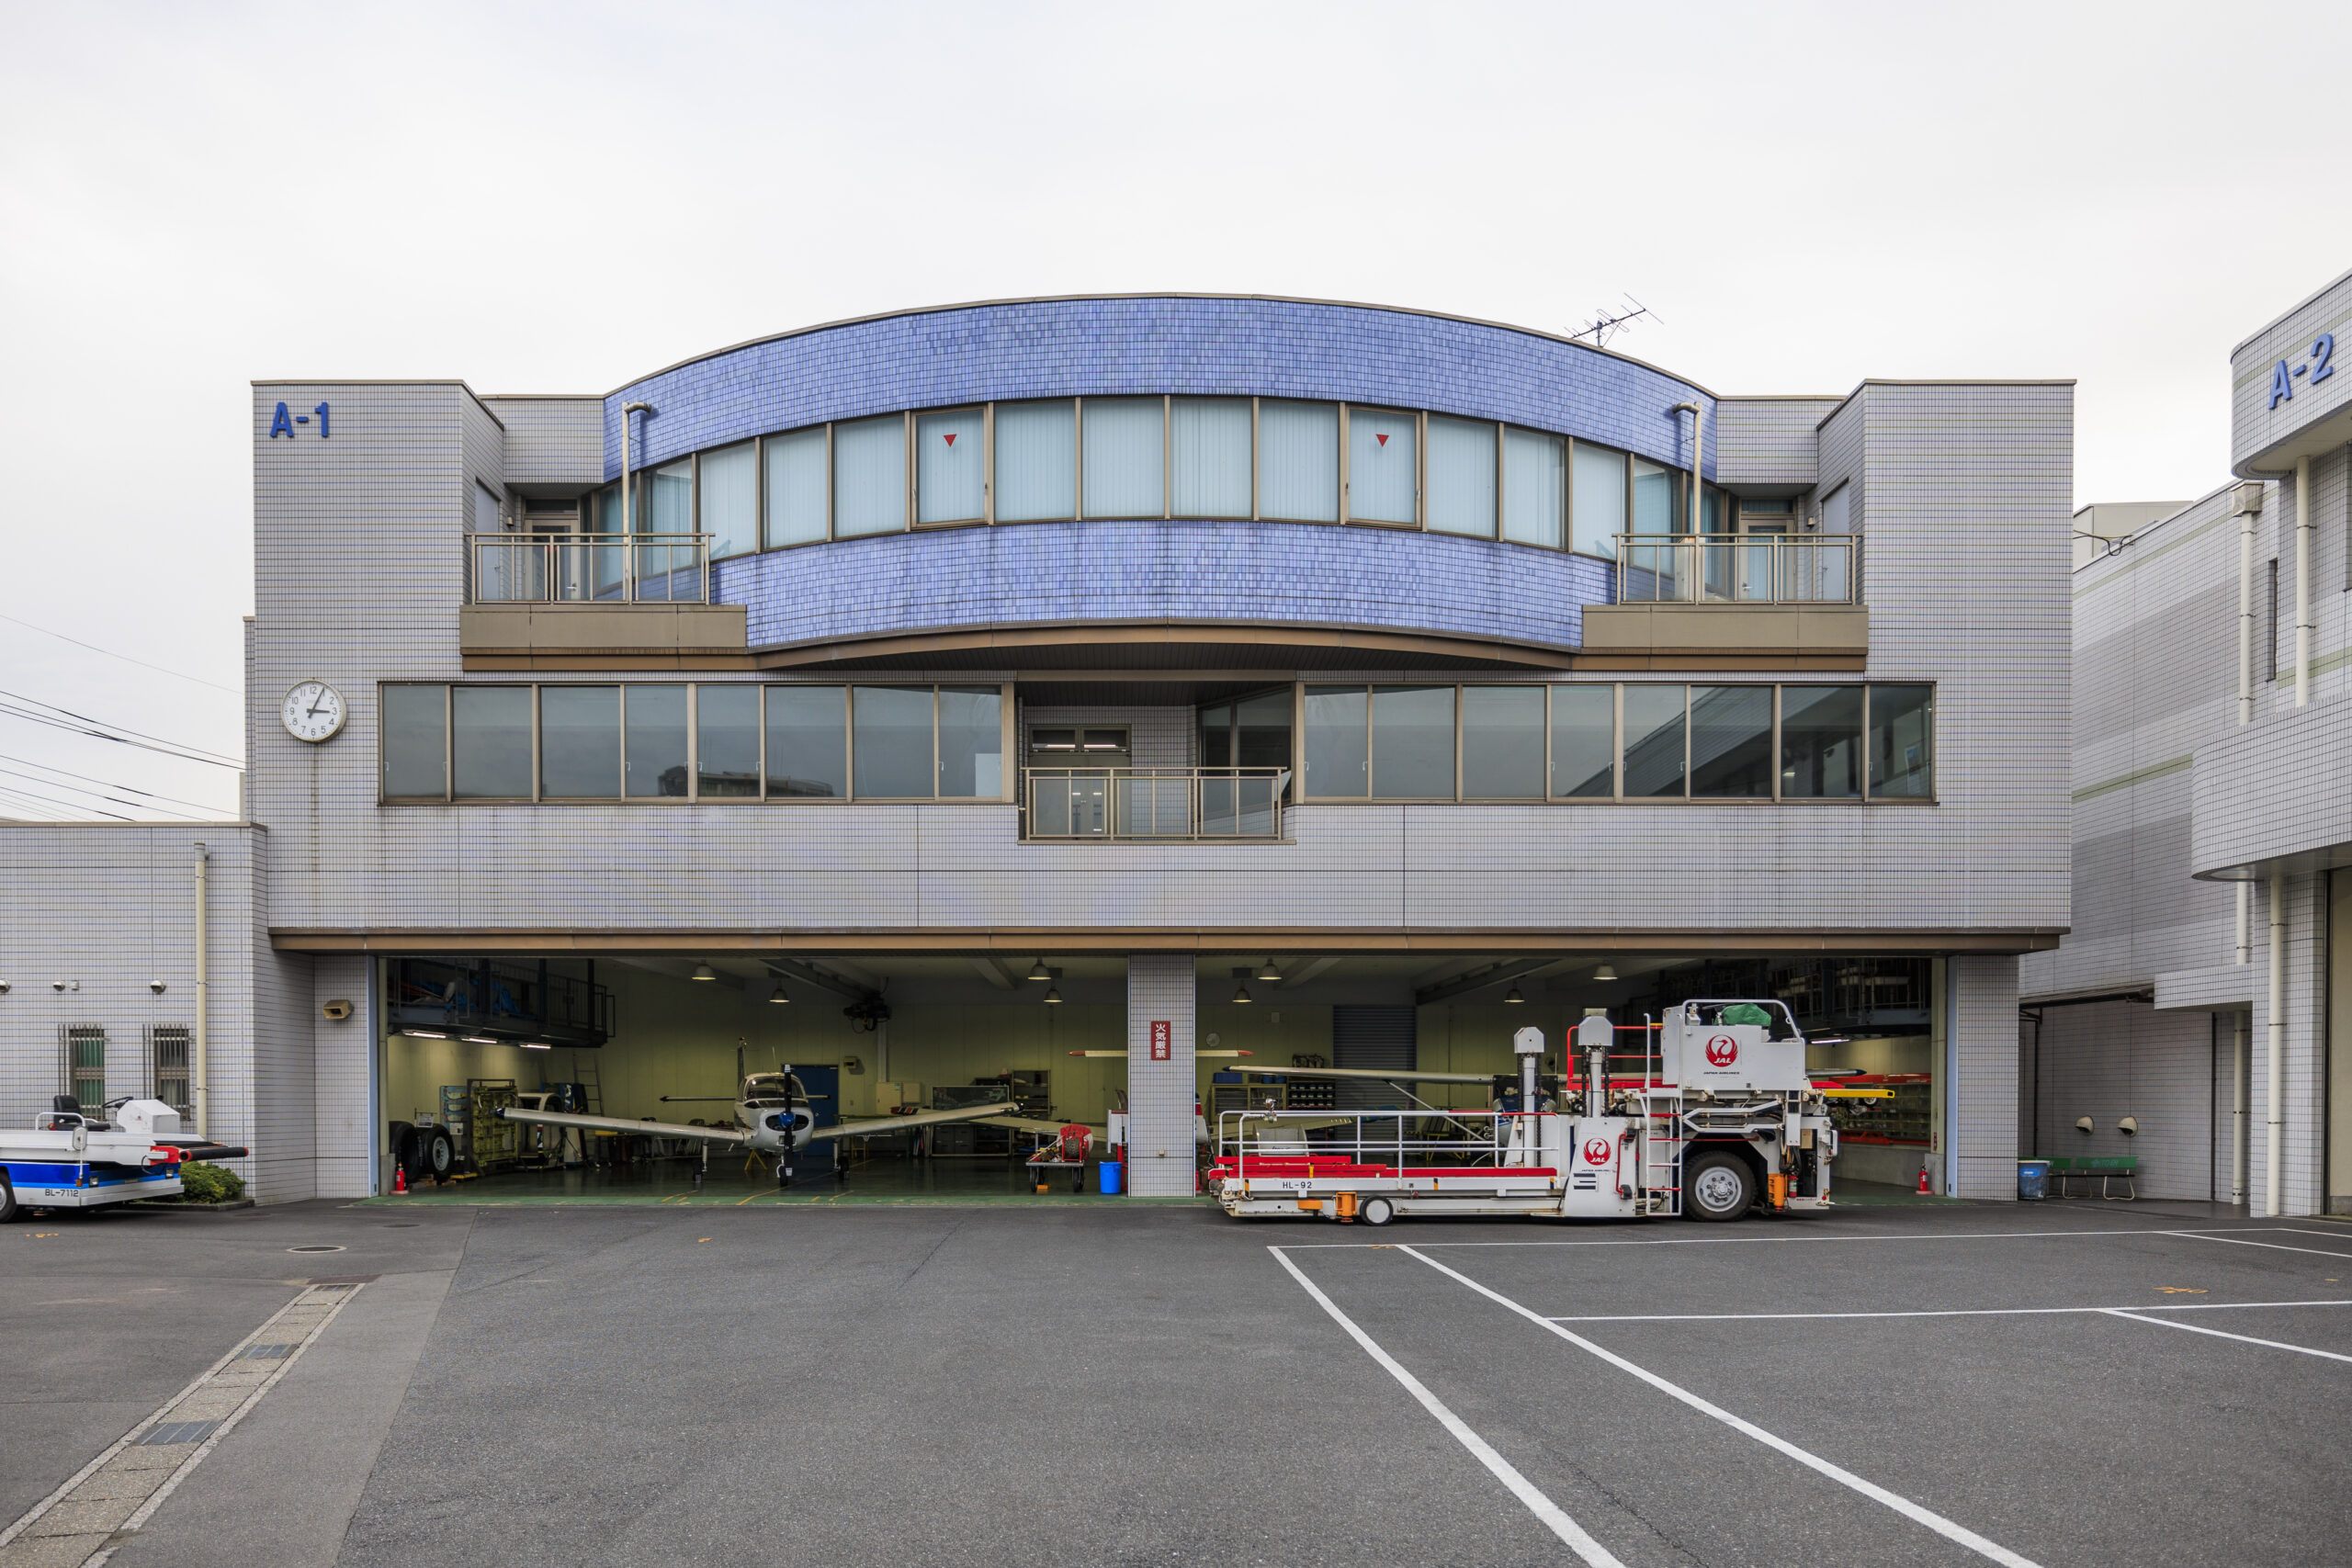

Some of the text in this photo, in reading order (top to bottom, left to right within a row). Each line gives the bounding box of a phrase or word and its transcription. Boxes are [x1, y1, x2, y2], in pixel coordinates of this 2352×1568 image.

[2268, 333, 2334, 410] A-2
[269, 401, 330, 437] A-1
[310, 686, 317, 694] 12
[292, 696, 299, 705] 10
[330, 696, 334, 705] 2
[292, 717, 298, 726] 8
[1155, 1022, 1167, 1058] 火気厳禁
[45, 1189, 79, 1197] BL-7112
